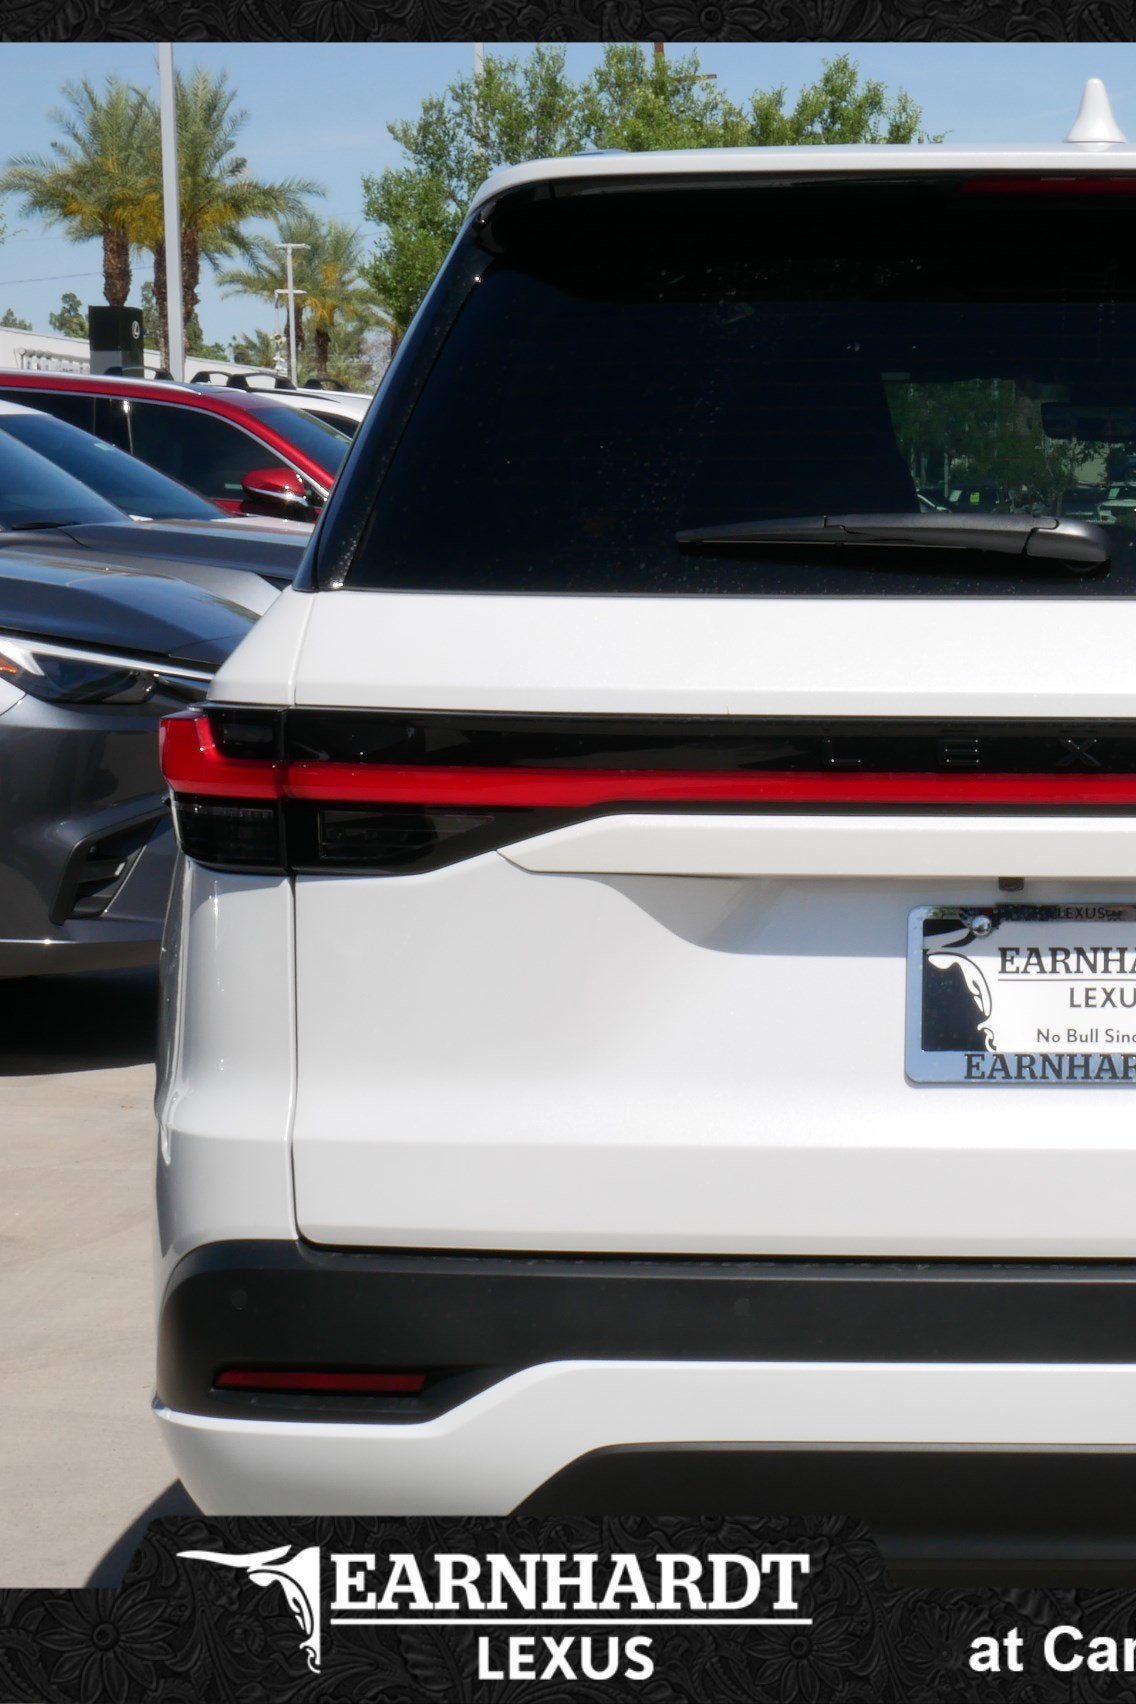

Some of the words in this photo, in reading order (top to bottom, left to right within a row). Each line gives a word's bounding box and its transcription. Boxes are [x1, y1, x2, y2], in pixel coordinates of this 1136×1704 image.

[1057, 906, 1106, 919] LEXUS
[1036, 1029, 1061, 1043] No
[1067, 1028, 1098, 1043] Bull
